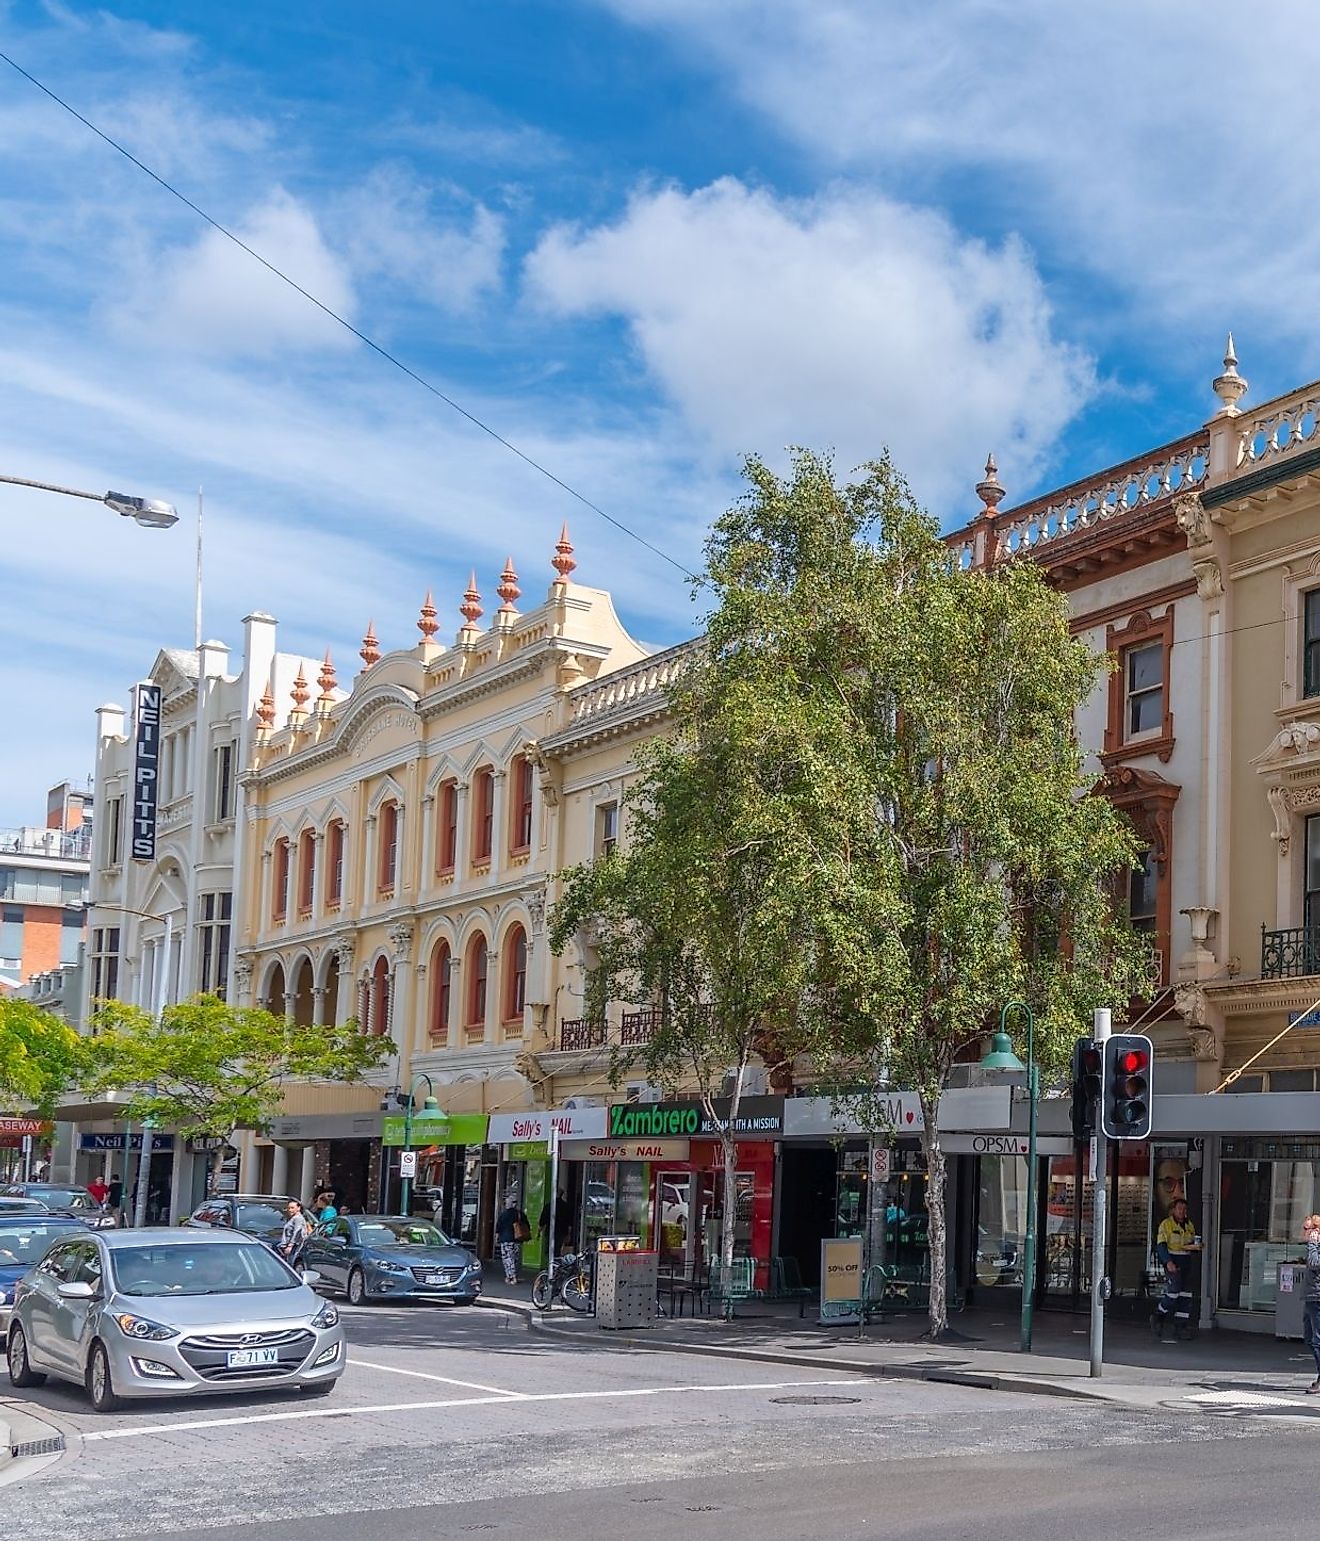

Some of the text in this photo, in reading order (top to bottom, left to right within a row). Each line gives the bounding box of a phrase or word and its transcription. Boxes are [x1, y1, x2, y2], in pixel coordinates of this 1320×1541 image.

[133, 689, 159, 856] NEIL PITT'S
[611, 1105, 699, 1135] Zambrero
[753, 1116, 780, 1129] MISSION
[512, 1120, 542, 1140] Sally's
[94, 1135, 121, 1148] Neil
[972, 1136, 1018, 1153] OPSM
[589, 1145, 664, 1159] Sally's NAIL
[845, 1264, 859, 1272] OFF
[246, 1351, 258, 1363] 71
